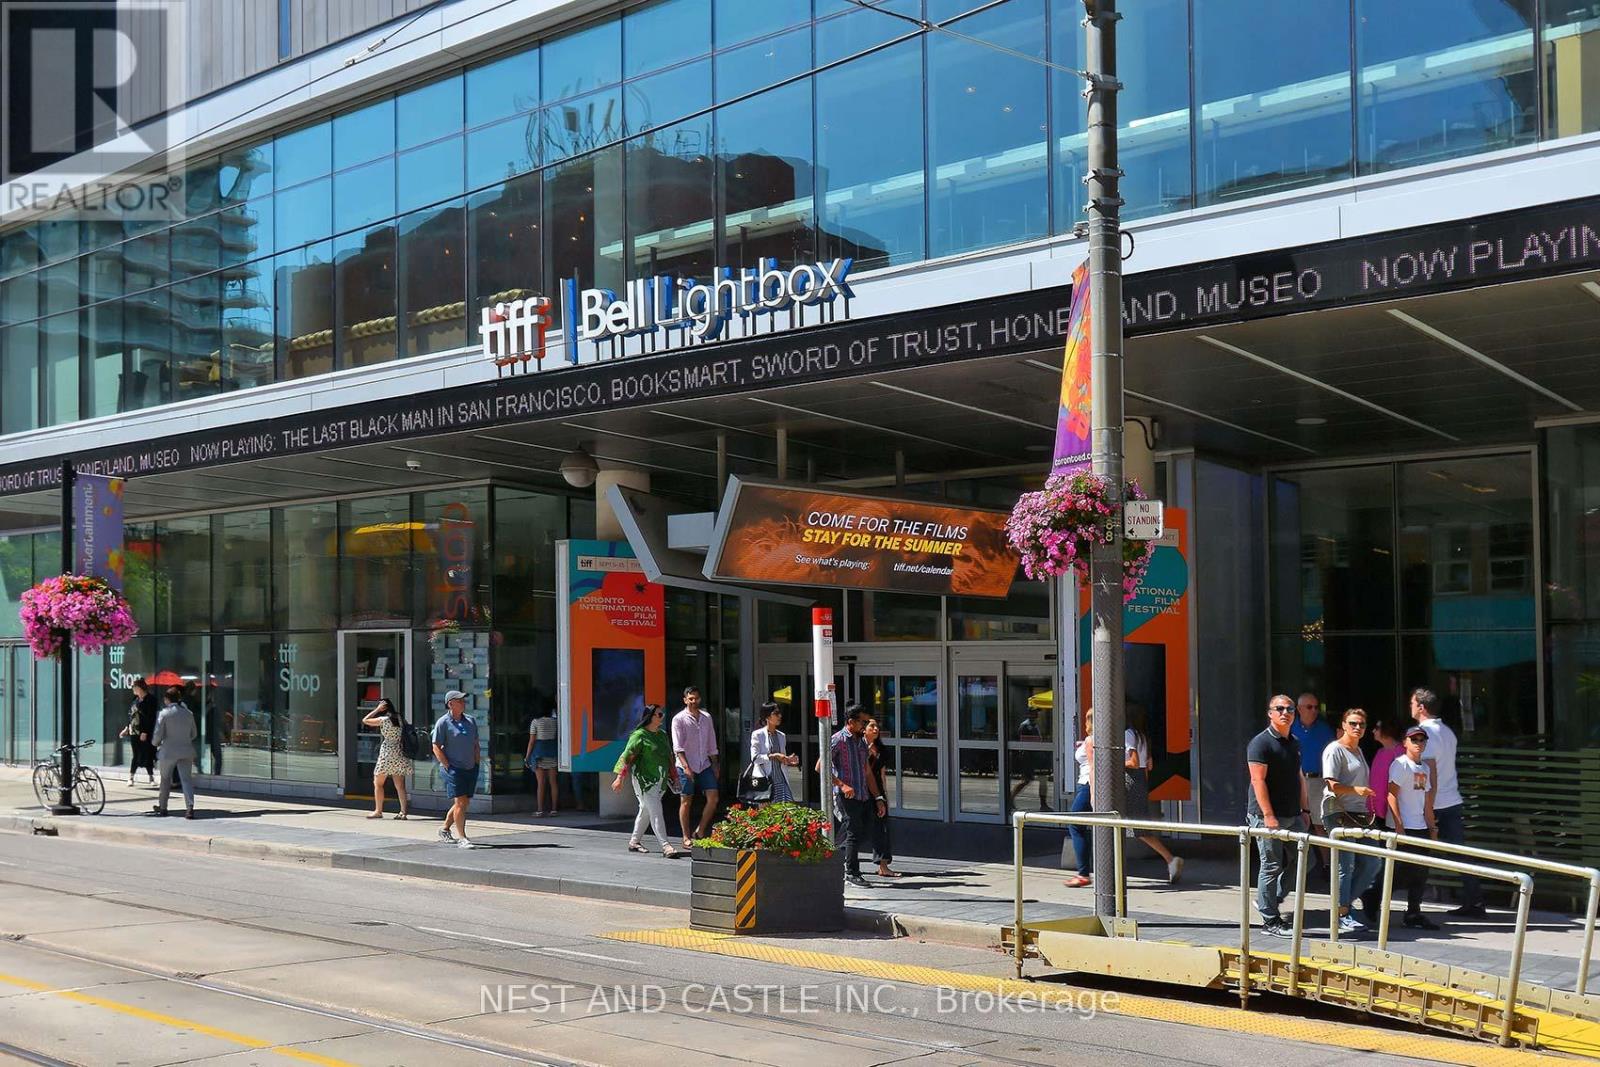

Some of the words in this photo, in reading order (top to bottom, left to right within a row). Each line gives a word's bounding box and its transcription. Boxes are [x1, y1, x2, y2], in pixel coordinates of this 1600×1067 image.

[478, 296, 551, 364] tiff
[581, 278, 654, 338] Bell
[653, 257, 852, 340] Lightbox
[0, 473, 21, 491] ORD
[23, 471, 35, 488] OF
[36, 467, 63, 486] TRUS
[140, 448, 179, 469] MUSEO
[190, 442, 220, 461] NOW
[222, 433, 276, 457] PLAYING:
[282, 427, 309, 449] THE
[313, 421, 346, 444] LAST
[350, 412, 399, 439] BLACK
[402, 408, 433, 431] MAN
[437, 404, 454, 426] IN
[457, 399, 491, 423] SAN
[496, 382, 606, 418] FRANCISCO,
[751, 344, 840, 380] SWORD
[849, 337, 880, 365] OF
[887, 321, 982, 359] TRUST,
[1197, 267, 1322, 315] MUSEO
[1362, 246, 1458, 290] NOW
[1139, 503, 1150, 513] NO
[807, 511, 854, 529] COME
[858, 516, 888, 533] FOR
[892, 519, 923, 536] THE
[923, 523, 968, 541] FILMS
[802, 528, 838, 545] STAY
[841, 532, 870, 548] FOR
[874, 534, 902, 551] THE
[904, 537, 963, 556] SUMMER
[580, 559, 592, 568] tiff
[795, 554, 813, 565] See
[813, 556, 838, 567] what's
[838, 557, 870, 571] playing:
[893, 562, 954, 576] tiff.net/calendar
[580, 604, 656, 613] INTERNATIONAL
[1154, 597, 1180, 605] FILM
[1128, 605, 1180, 615] FESTIVAL
[611, 619, 656, 627] FESTIVAL
[109, 646, 125, 665] tiff
[279, 643, 299, 664] tiff
[280, 668, 320, 697] Shop
